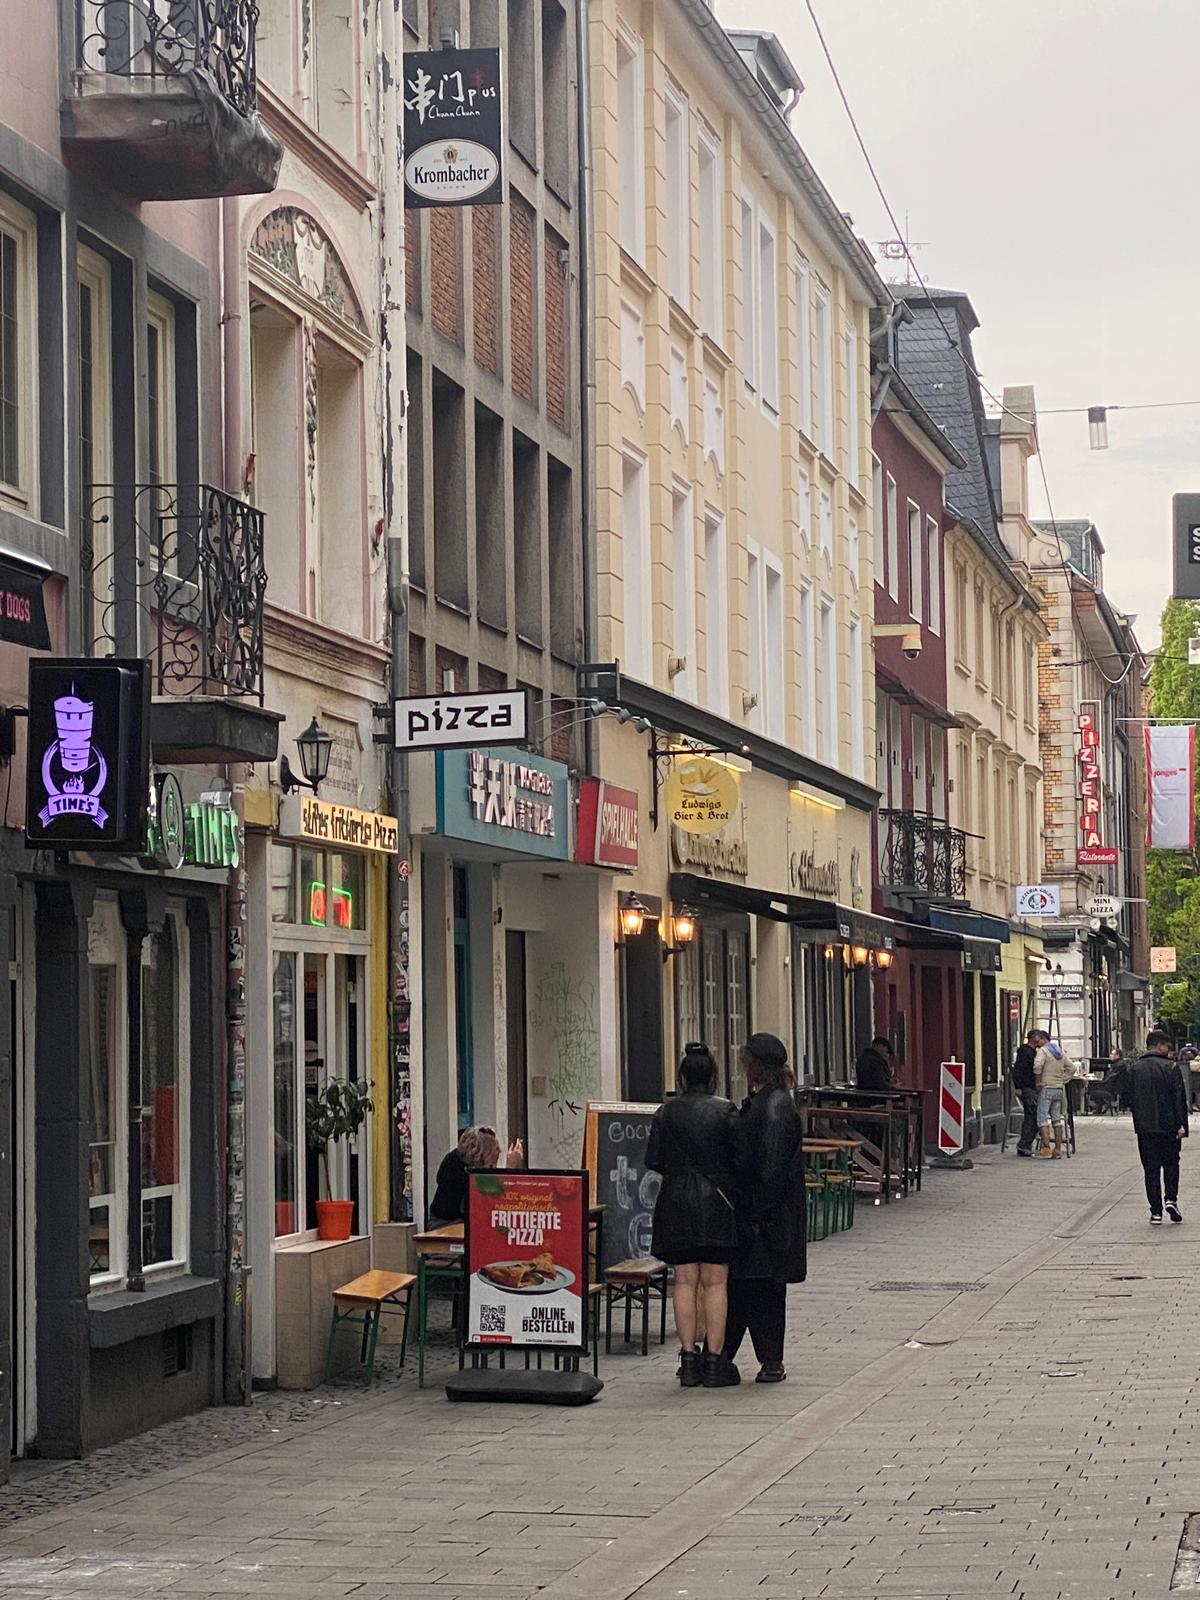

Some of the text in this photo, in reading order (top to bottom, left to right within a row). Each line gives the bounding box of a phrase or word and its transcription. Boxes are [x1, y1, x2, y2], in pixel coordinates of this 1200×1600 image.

[414, 165, 490, 184] Krombacher
[6, 593, 31, 623] DOGS
[408, 701, 511, 741] pizza
[1079, 715, 1100, 847] PIZZERIA
[53, 797, 95, 813] TIME'S
[681, 799, 721, 809] Ludwigs
[674, 811, 729, 821] Bier & Brot
[601, 801, 638, 850] SPIELHALLE
[1079, 850, 1116, 861] Ristorante
[491, 1210, 561, 1230] FRITTIERTE
[507, 1228, 544, 1246] PIZZA
[531, 1306, 566, 1321] ONLINE
[522, 1320, 575, 1334] BESTELLEN
